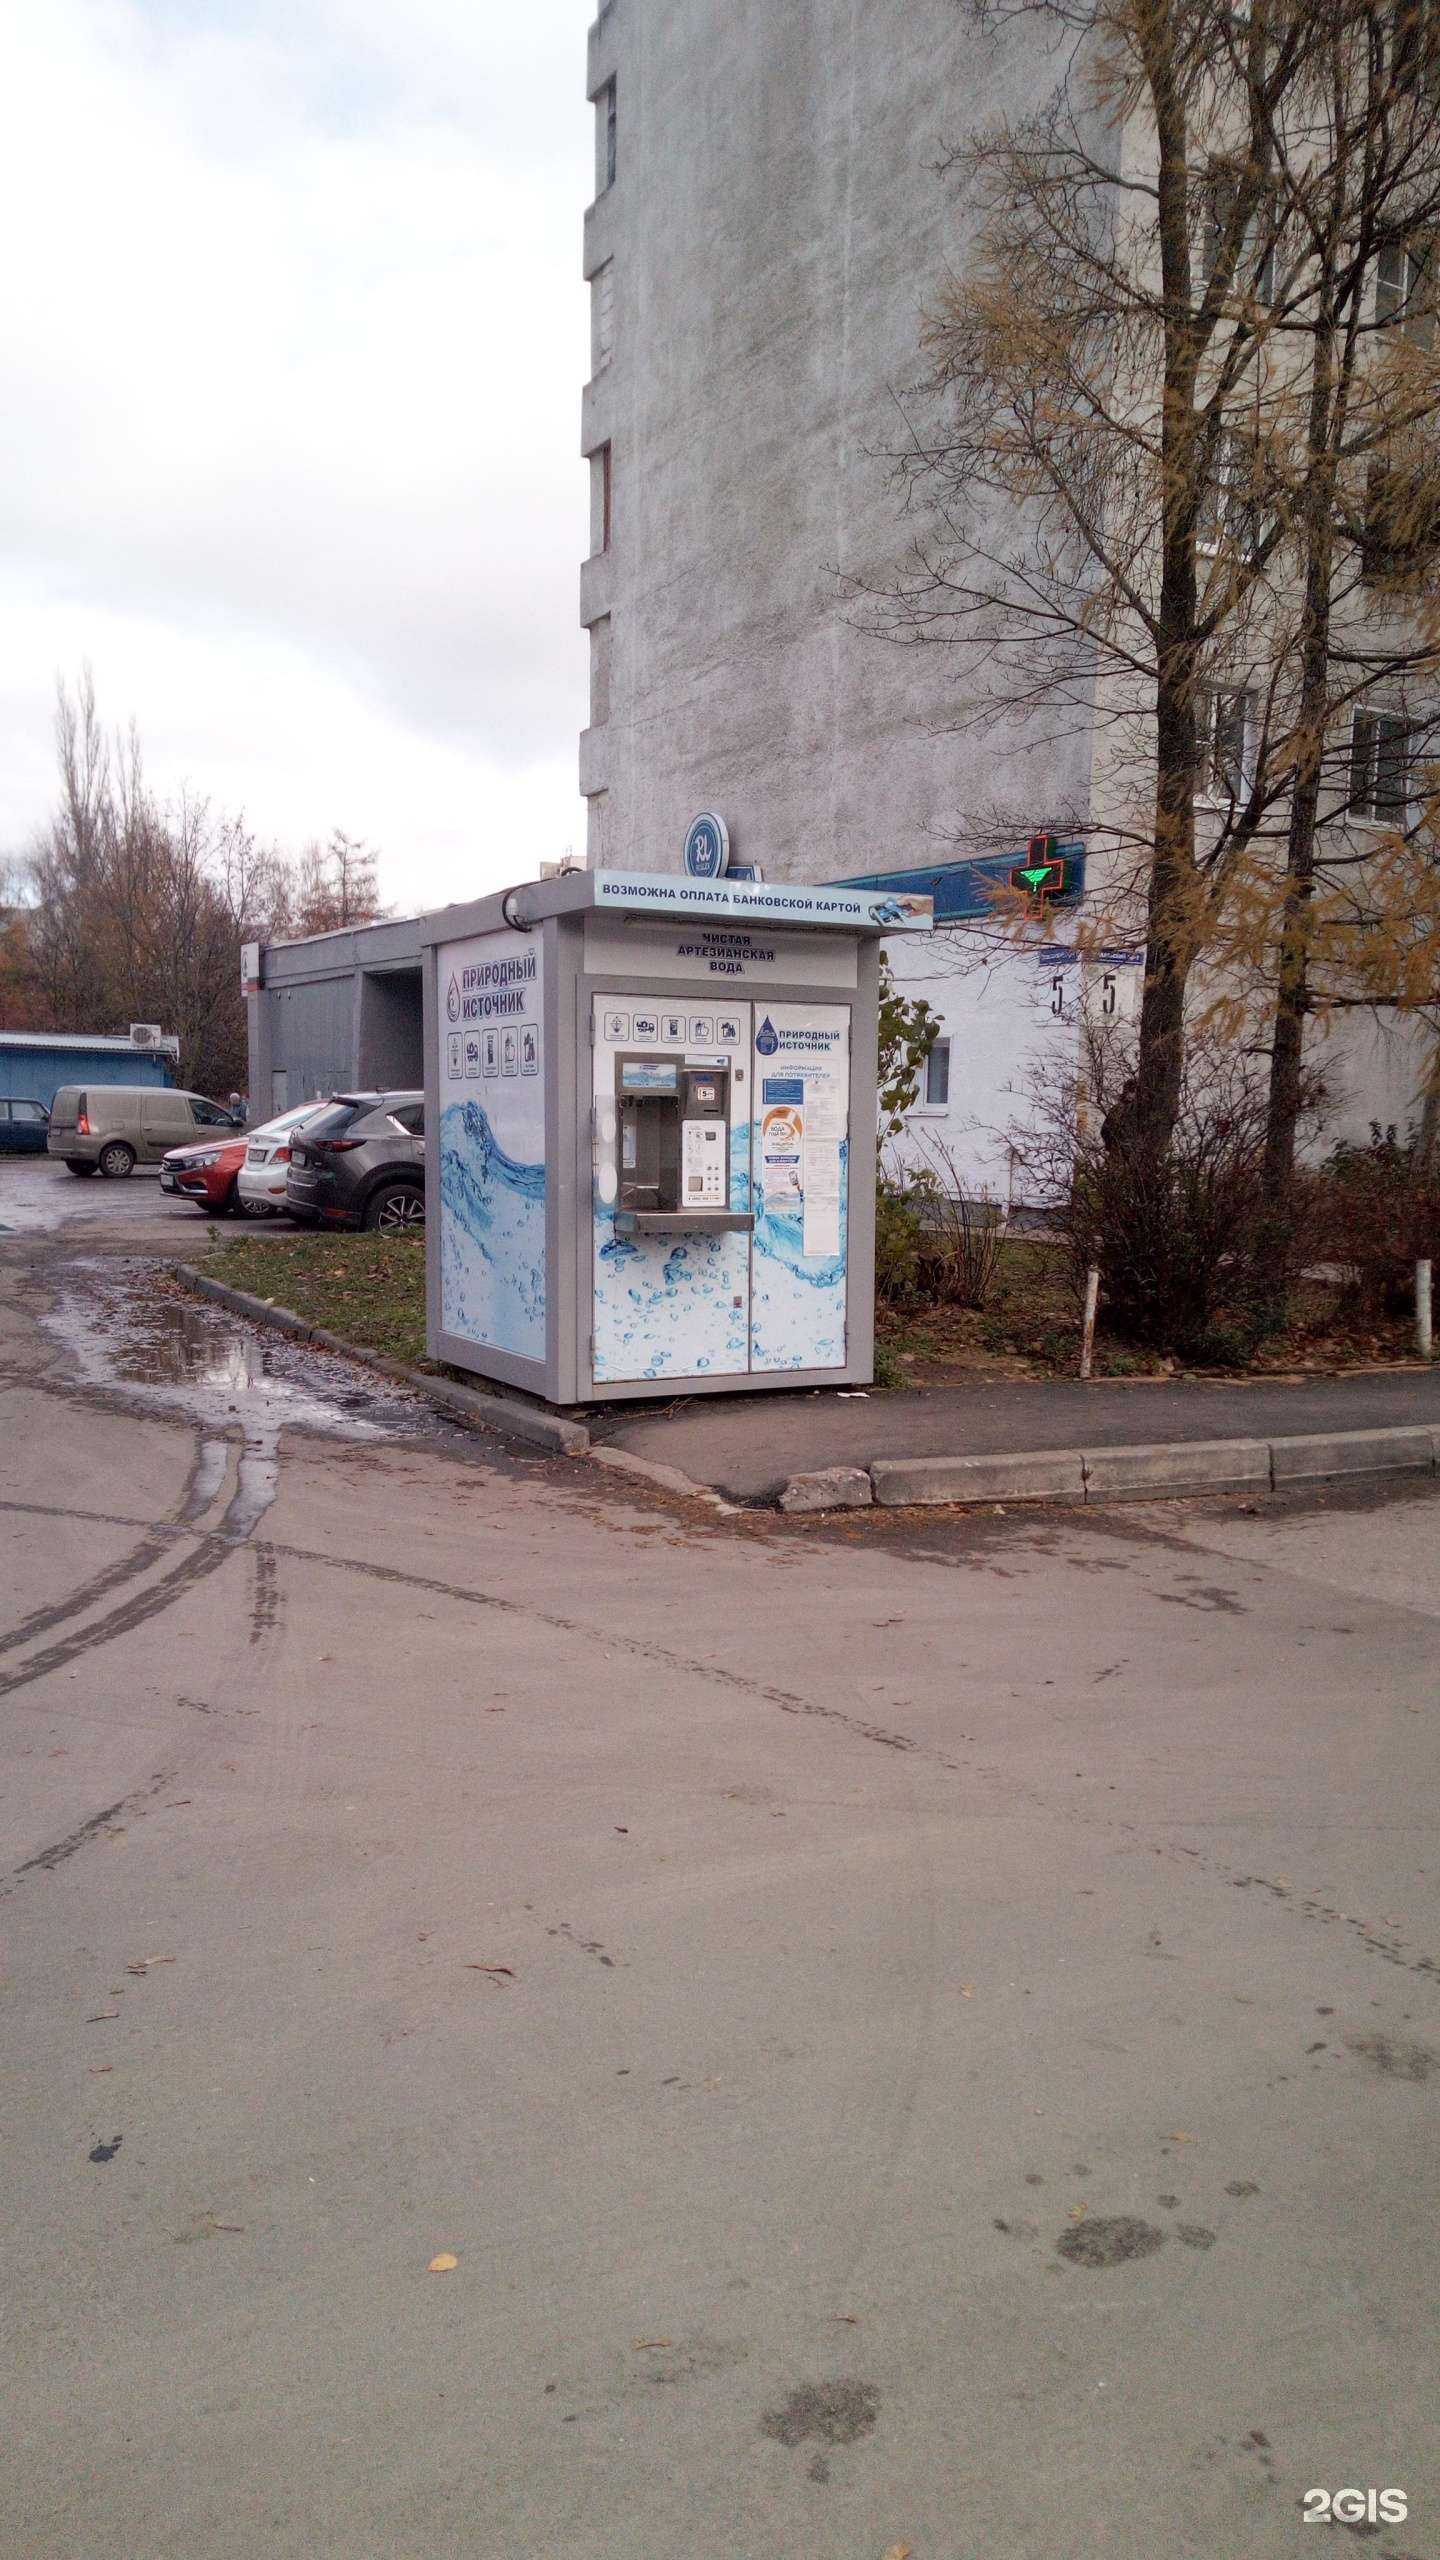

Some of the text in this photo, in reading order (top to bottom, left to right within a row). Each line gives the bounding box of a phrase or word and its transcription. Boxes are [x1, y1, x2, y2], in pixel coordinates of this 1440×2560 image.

[602, 884, 861, 913] ВОЗМОЖНА ОПЛАТА БАНКОВСКОЙ КАРТОЙ
[702, 933, 751, 945] ЧИСТАЯ
[678, 945, 775, 961] АРТЕЗИАНСКАЯ
[462, 948, 537, 988] ПРИРОДНЫЙ
[710, 961, 744, 974] ВОДА
[462, 990, 525, 1018] ИСТОЧНИК
[1052, 975, 1063, 1015] 5
[1102, 974, 1116, 1014] 5
[779, 1030, 840, 1041] ПРИРОДНЫЙ
[779, 1041, 831, 1051] ИСТОЧНИК
